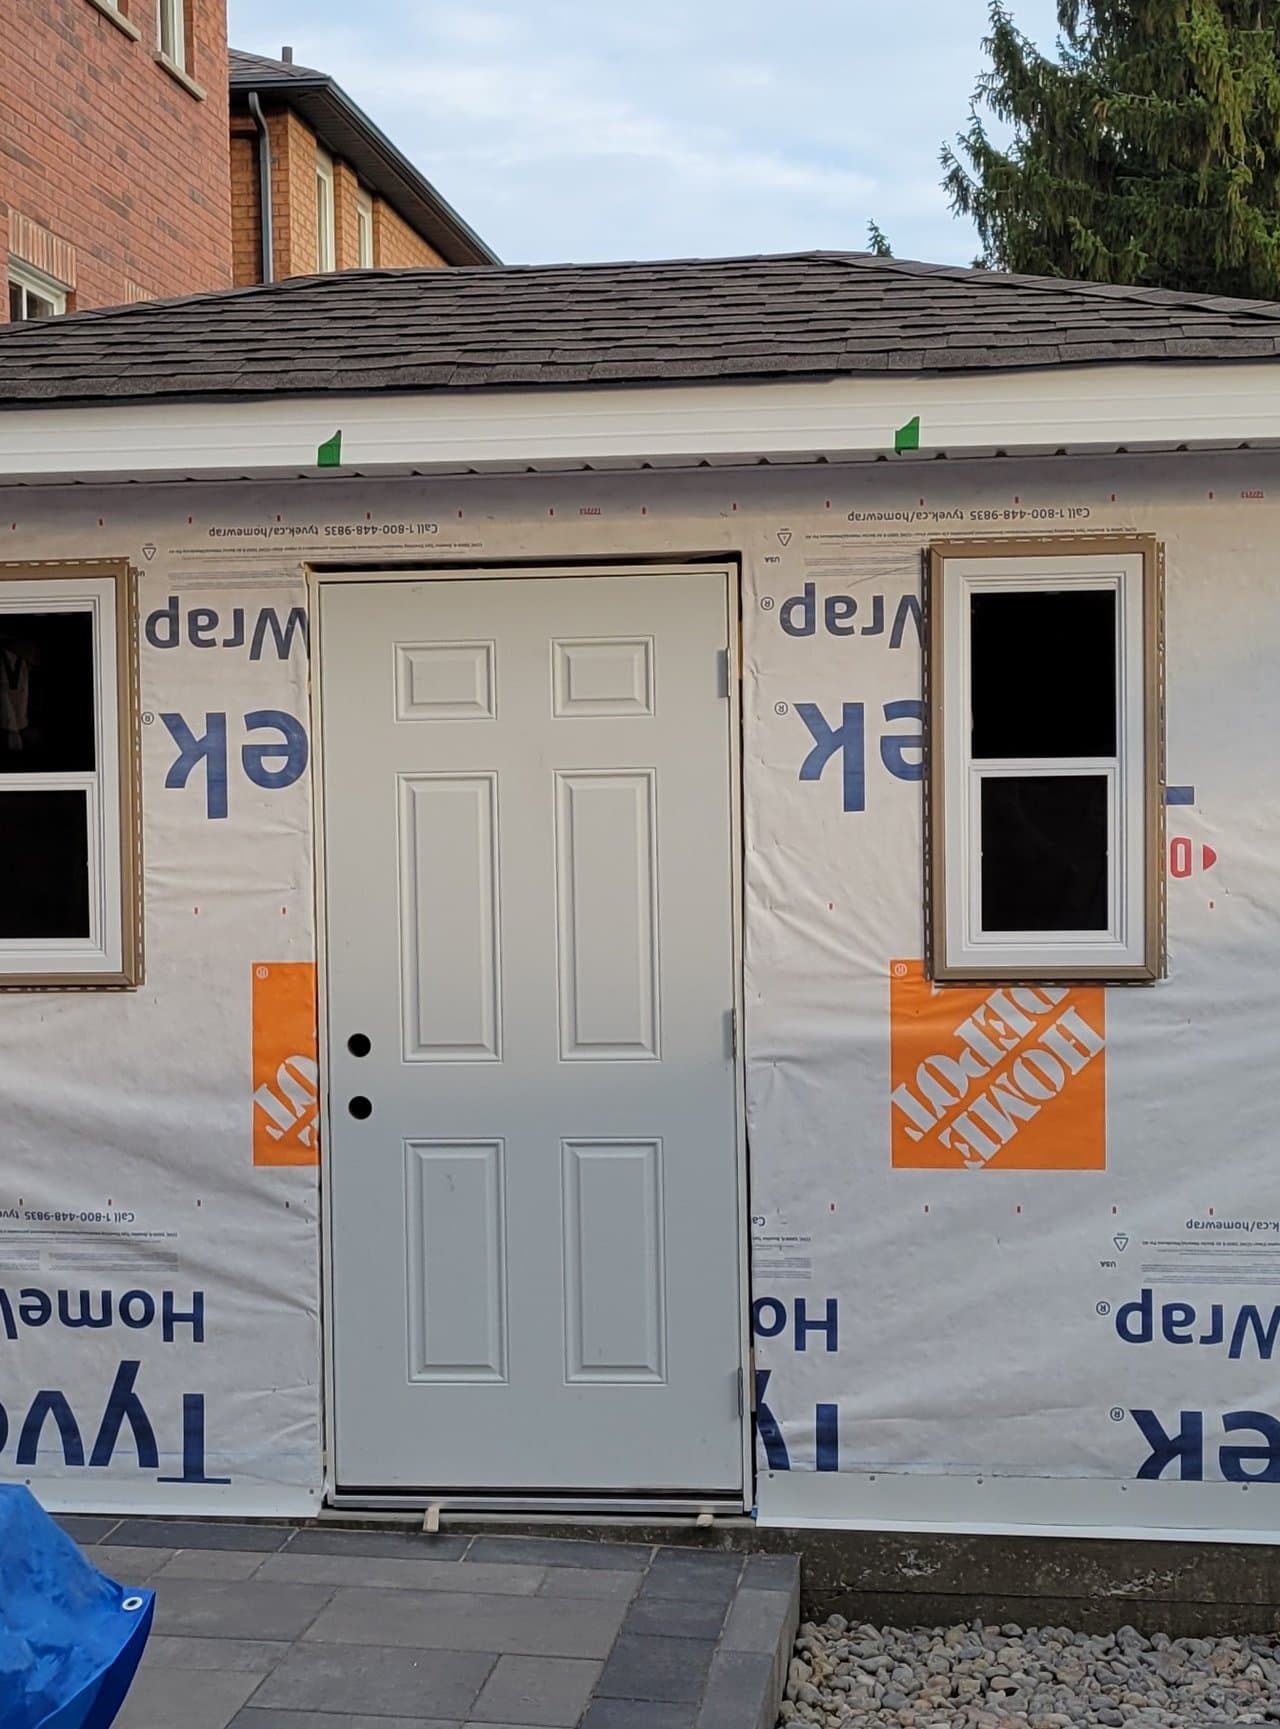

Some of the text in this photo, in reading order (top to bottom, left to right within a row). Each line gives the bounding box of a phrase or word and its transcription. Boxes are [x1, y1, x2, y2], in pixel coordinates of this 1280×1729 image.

[847, 507, 1090, 523] Call 1-800-448-9835 tyvek.ca/homewrap
[208, 523, 438, 538] Call 1-800-448-9835 tyvek.ca/homewrap
[764, 556, 780, 564] USA
[937, 1005, 1105, 1170] HOME
[24, 1210, 112, 1223] 1-800-448-9835
[114, 1211, 135, 1223] Call
[1100, 1260, 1117, 1269] USA
